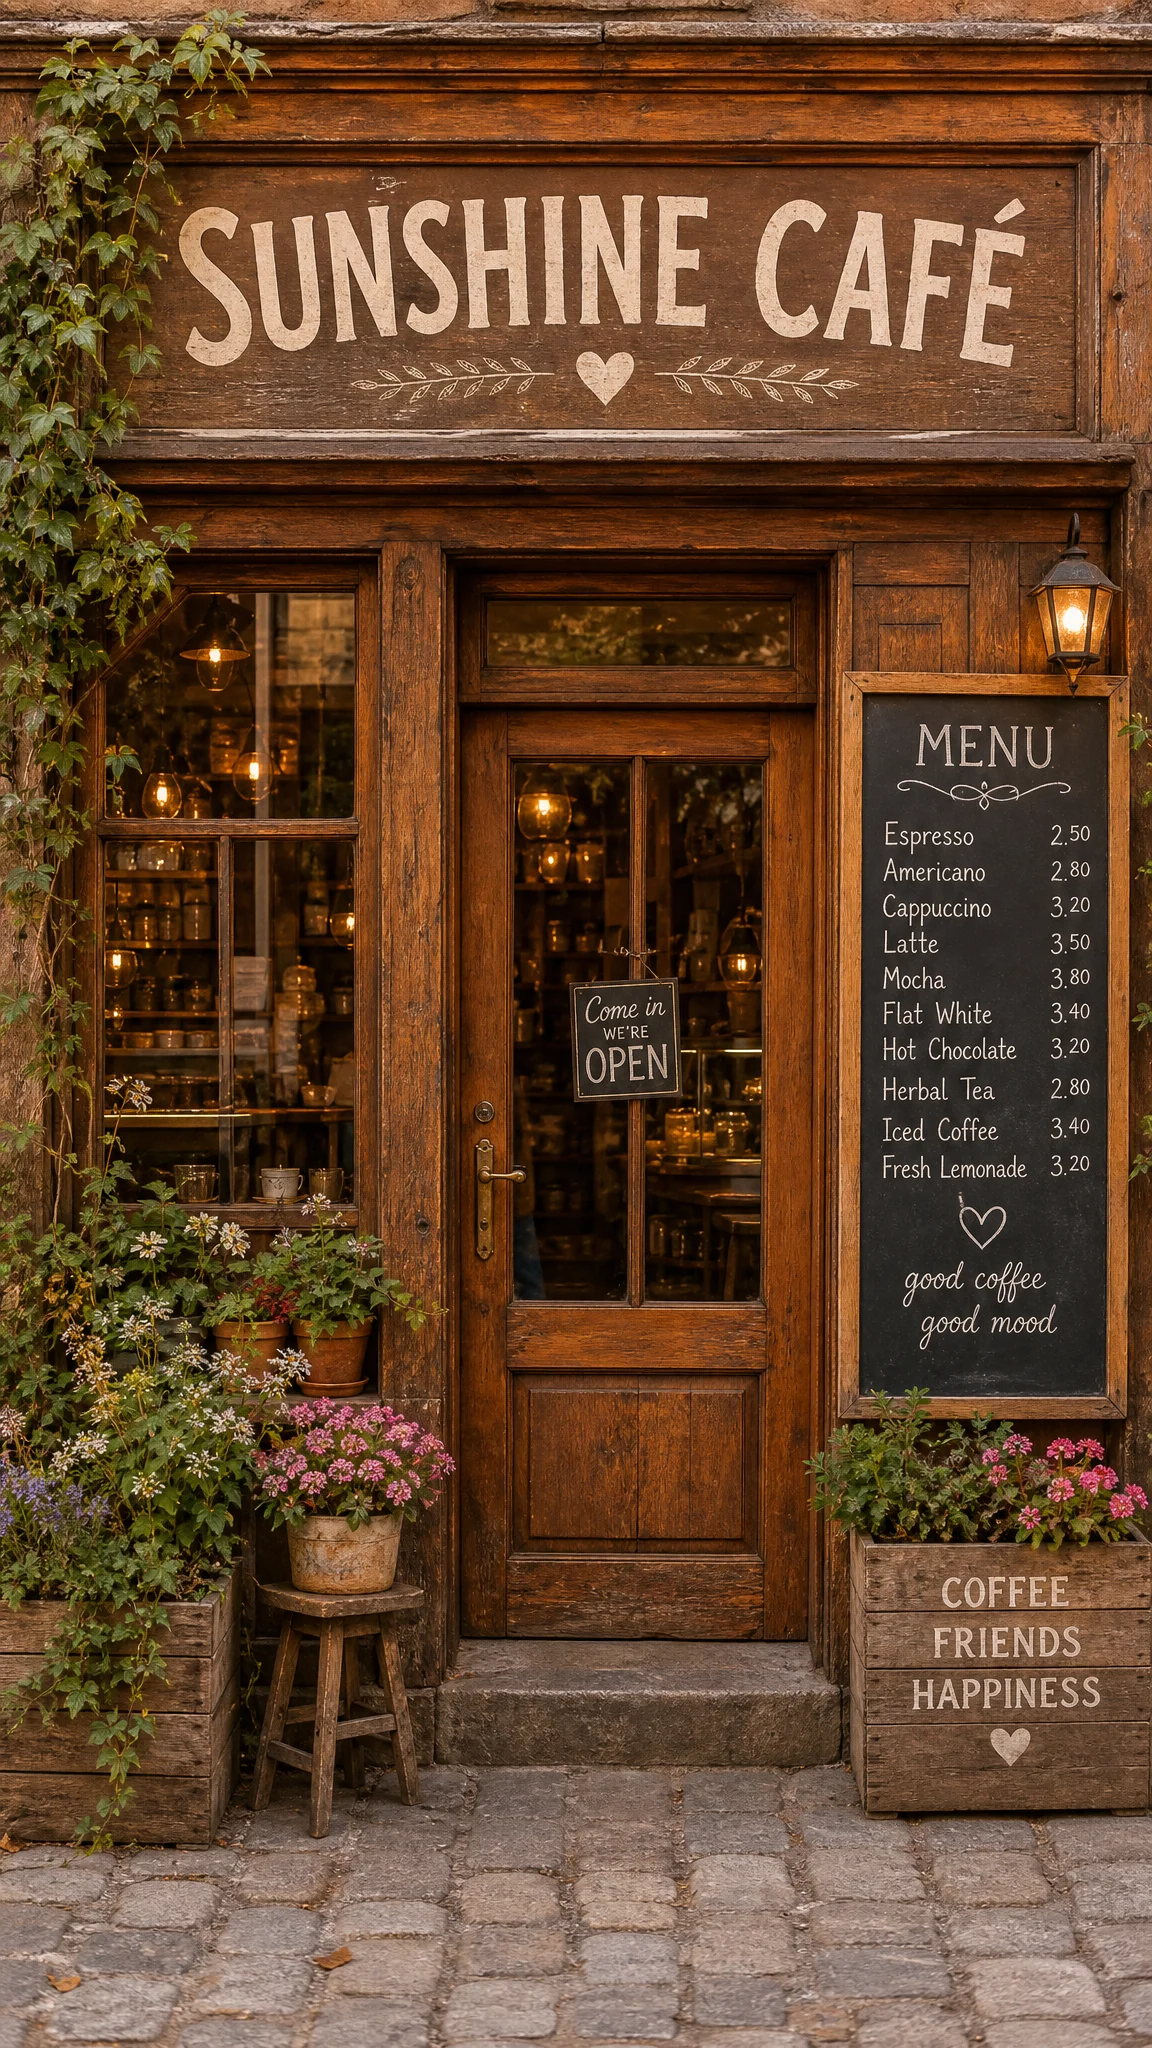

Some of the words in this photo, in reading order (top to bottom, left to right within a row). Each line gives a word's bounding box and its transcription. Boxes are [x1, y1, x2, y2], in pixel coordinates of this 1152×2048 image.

[179, 195, 708, 366] SUNSHINE
[755, 198, 1025, 367] CAFÉ
[916, 724, 1054, 769] MENU
[885, 821, 974, 854] Espresso
[1051, 825, 1090, 846] 2.50
[883, 858, 985, 882] Americano
[1051, 861, 1090, 882] 2.80
[883, 894, 992, 926] Cappuccino
[1051, 897, 1090, 918] 3.20
[884, 931, 939, 954] Latte
[1051, 933, 1090, 954] 3.50
[883, 966, 946, 989] Mocha
[1051, 968, 1090, 989] 3.80
[585, 996, 639, 1024] Come
[646, 996, 666, 1016] in
[883, 1002, 923, 1024] Flat
[936, 1001, 992, 1024] White
[1051, 1003, 1090, 1024] 3.40
[603, 1025, 649, 1040] WE'RE
[585, 1044, 668, 1083] OPEN
[883, 1037, 916, 1060] Hot
[929, 1037, 1017, 1060] Chocolate
[1051, 1038, 1090, 1059] 3.20
[883, 1078, 948, 1101] Herbal
[960, 1077, 995, 1100] Tea
[1051, 1079, 1090, 1099] 2.80
[883, 1118, 925, 1142] Iced
[938, 1118, 998, 1141] Coffee
[1051, 1118, 1090, 1139] 3.40
[883, 1155, 931, 1178] Fresh
[940, 1155, 1027, 1179] Lemonade
[1051, 1156, 1090, 1176] 3.20
[903, 1261, 965, 1307] good
[975, 1261, 1046, 1302] coffee
[919, 1304, 980, 1350] good
[991, 1304, 1058, 1334] mood
[941, 1576, 1070, 1608] COFFEE
[934, 1626, 1081, 1659] FRIENDS
[912, 1676, 1101, 1710] HAPPINESS
